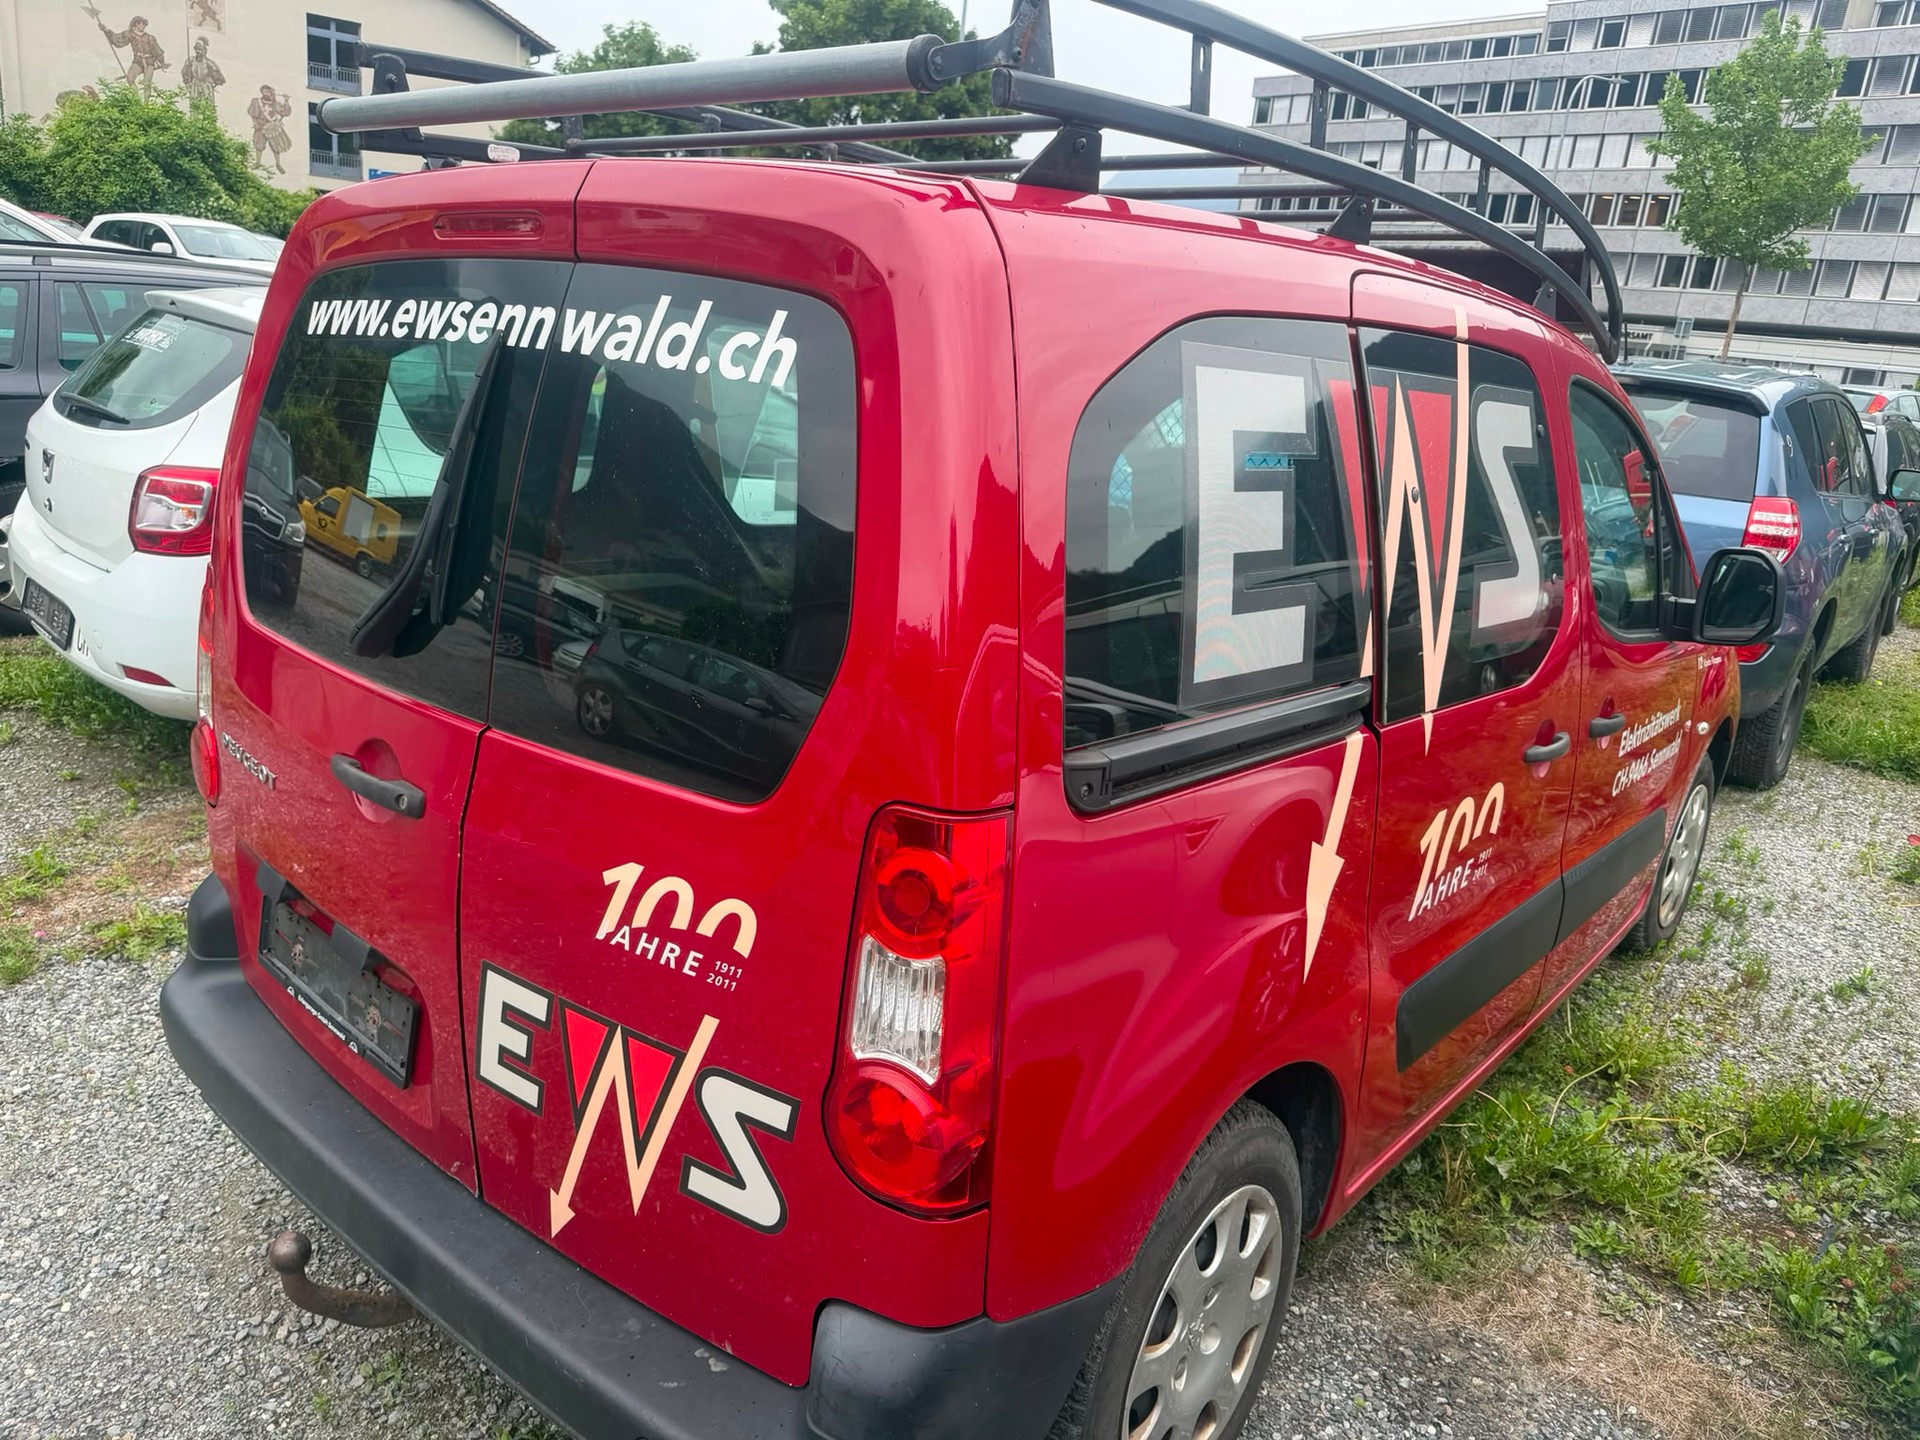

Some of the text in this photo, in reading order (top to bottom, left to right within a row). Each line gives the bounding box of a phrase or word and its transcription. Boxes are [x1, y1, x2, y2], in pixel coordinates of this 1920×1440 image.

[1178, 304, 1541, 755] EWS
[221, 731, 279, 791] PEUGEOT
[1408, 781, 1505, 921] 100
[596, 861, 758, 959] 100
[706, 972, 738, 992] 2011
[714, 960, 743, 980] 1911
[475, 960, 802, 1239] EWS
